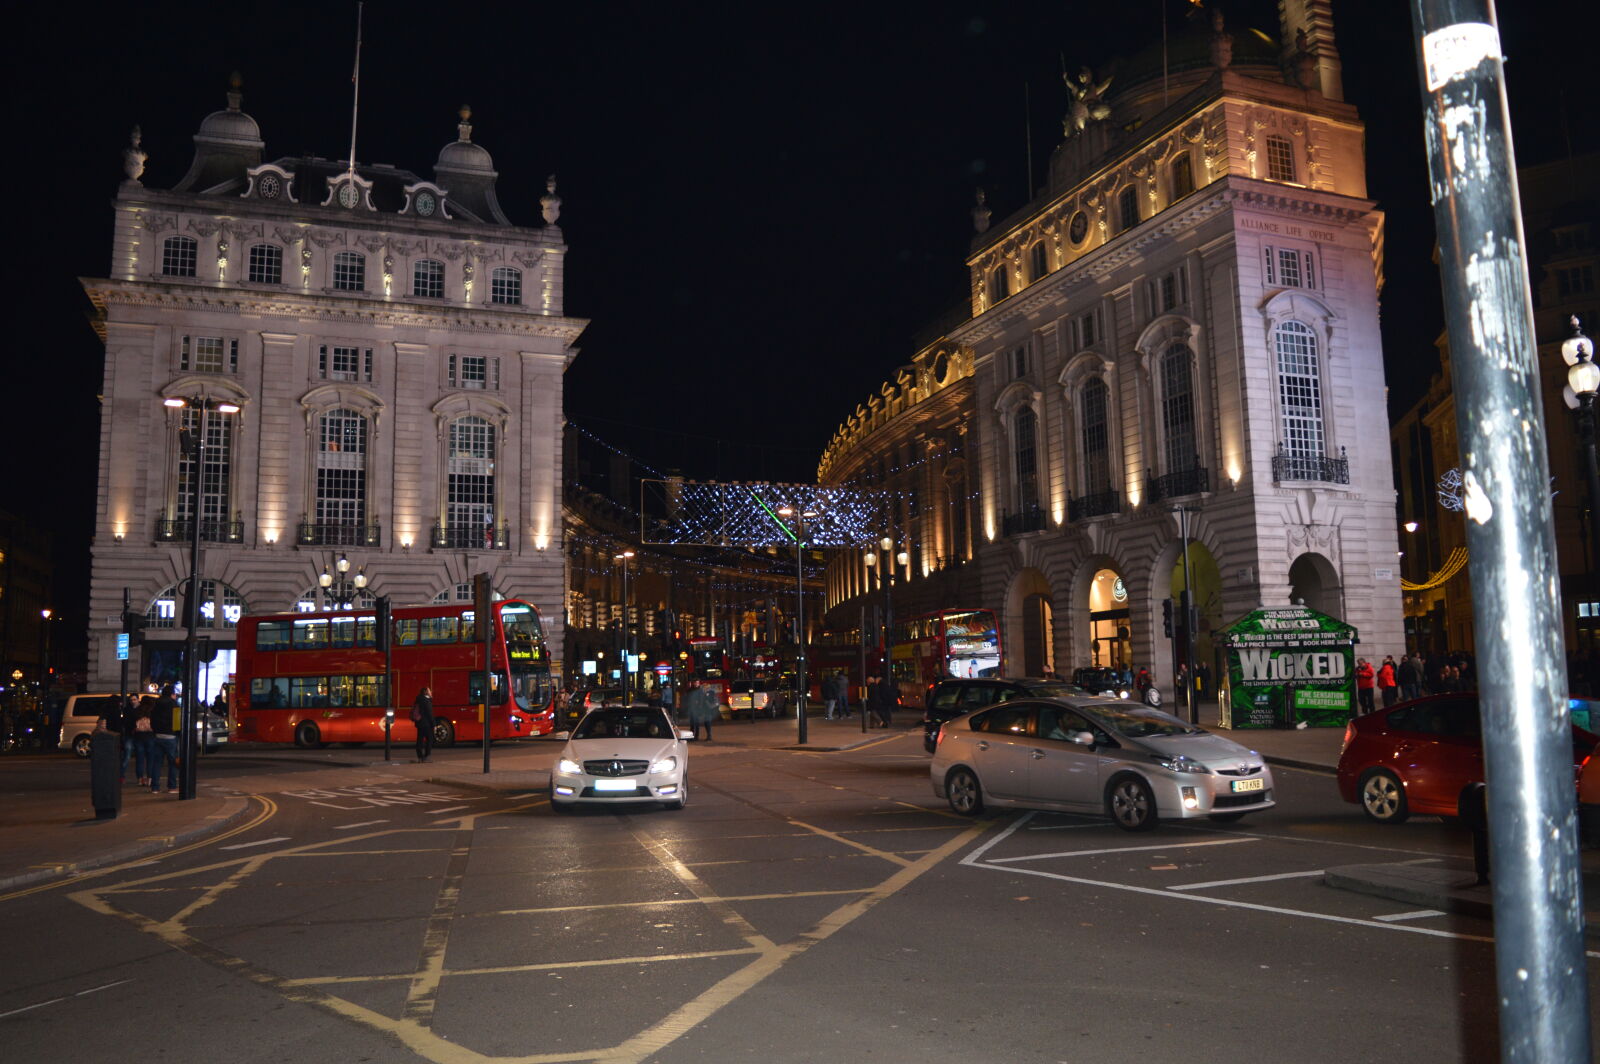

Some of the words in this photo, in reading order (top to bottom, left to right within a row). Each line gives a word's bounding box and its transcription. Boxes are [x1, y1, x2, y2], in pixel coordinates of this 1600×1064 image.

[1241, 218, 1279, 233] ALLIANCE
[1286, 226, 1302, 236] LIFE
[1309, 231, 1335, 241] OFFICE
[1316, 691, 1344, 699] SENSATION
[279, 786, 409, 799] BUS
[308, 791, 488, 810] LANE
